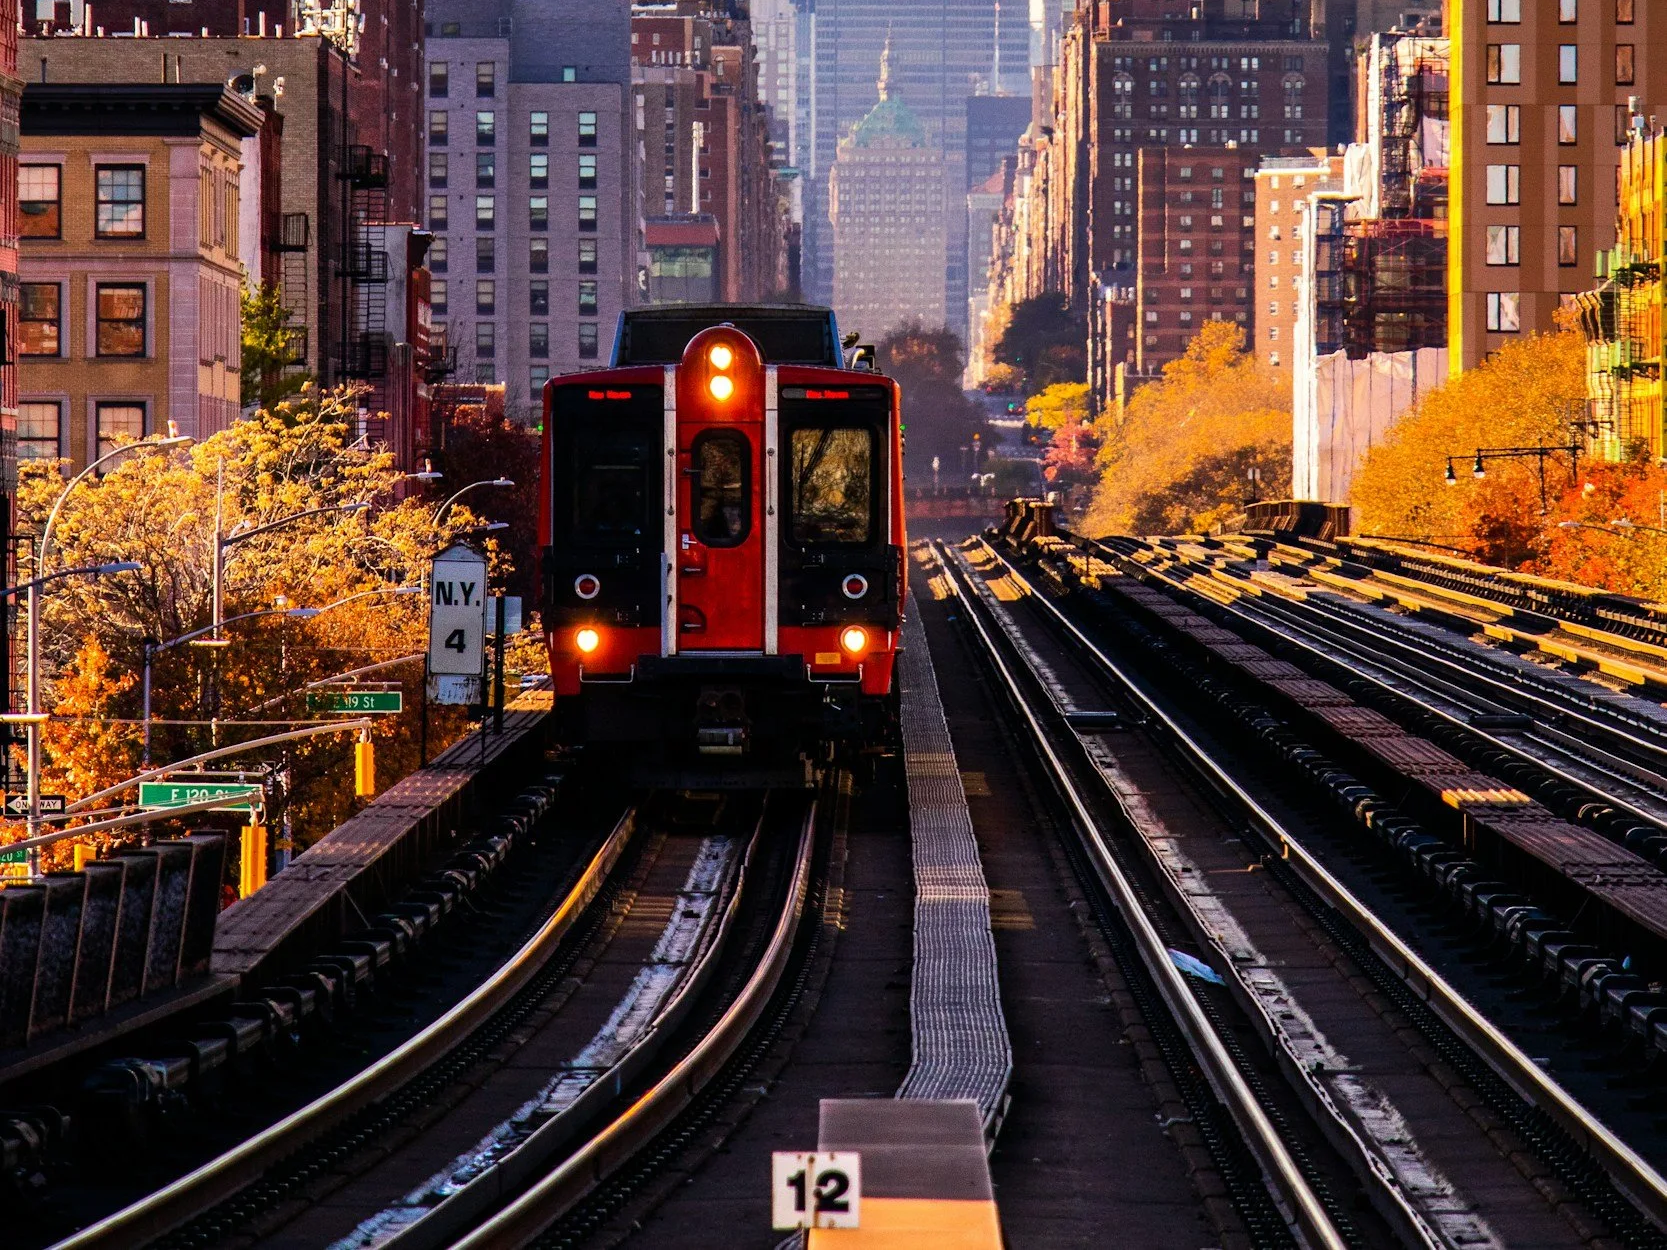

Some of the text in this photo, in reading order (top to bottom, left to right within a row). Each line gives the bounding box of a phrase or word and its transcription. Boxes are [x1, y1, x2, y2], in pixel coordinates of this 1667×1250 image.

[435, 581, 480, 606] N.Y.
[445, 629, 466, 653] 4
[363, 696, 374, 709] St
[787, 1169, 849, 1212] 12
